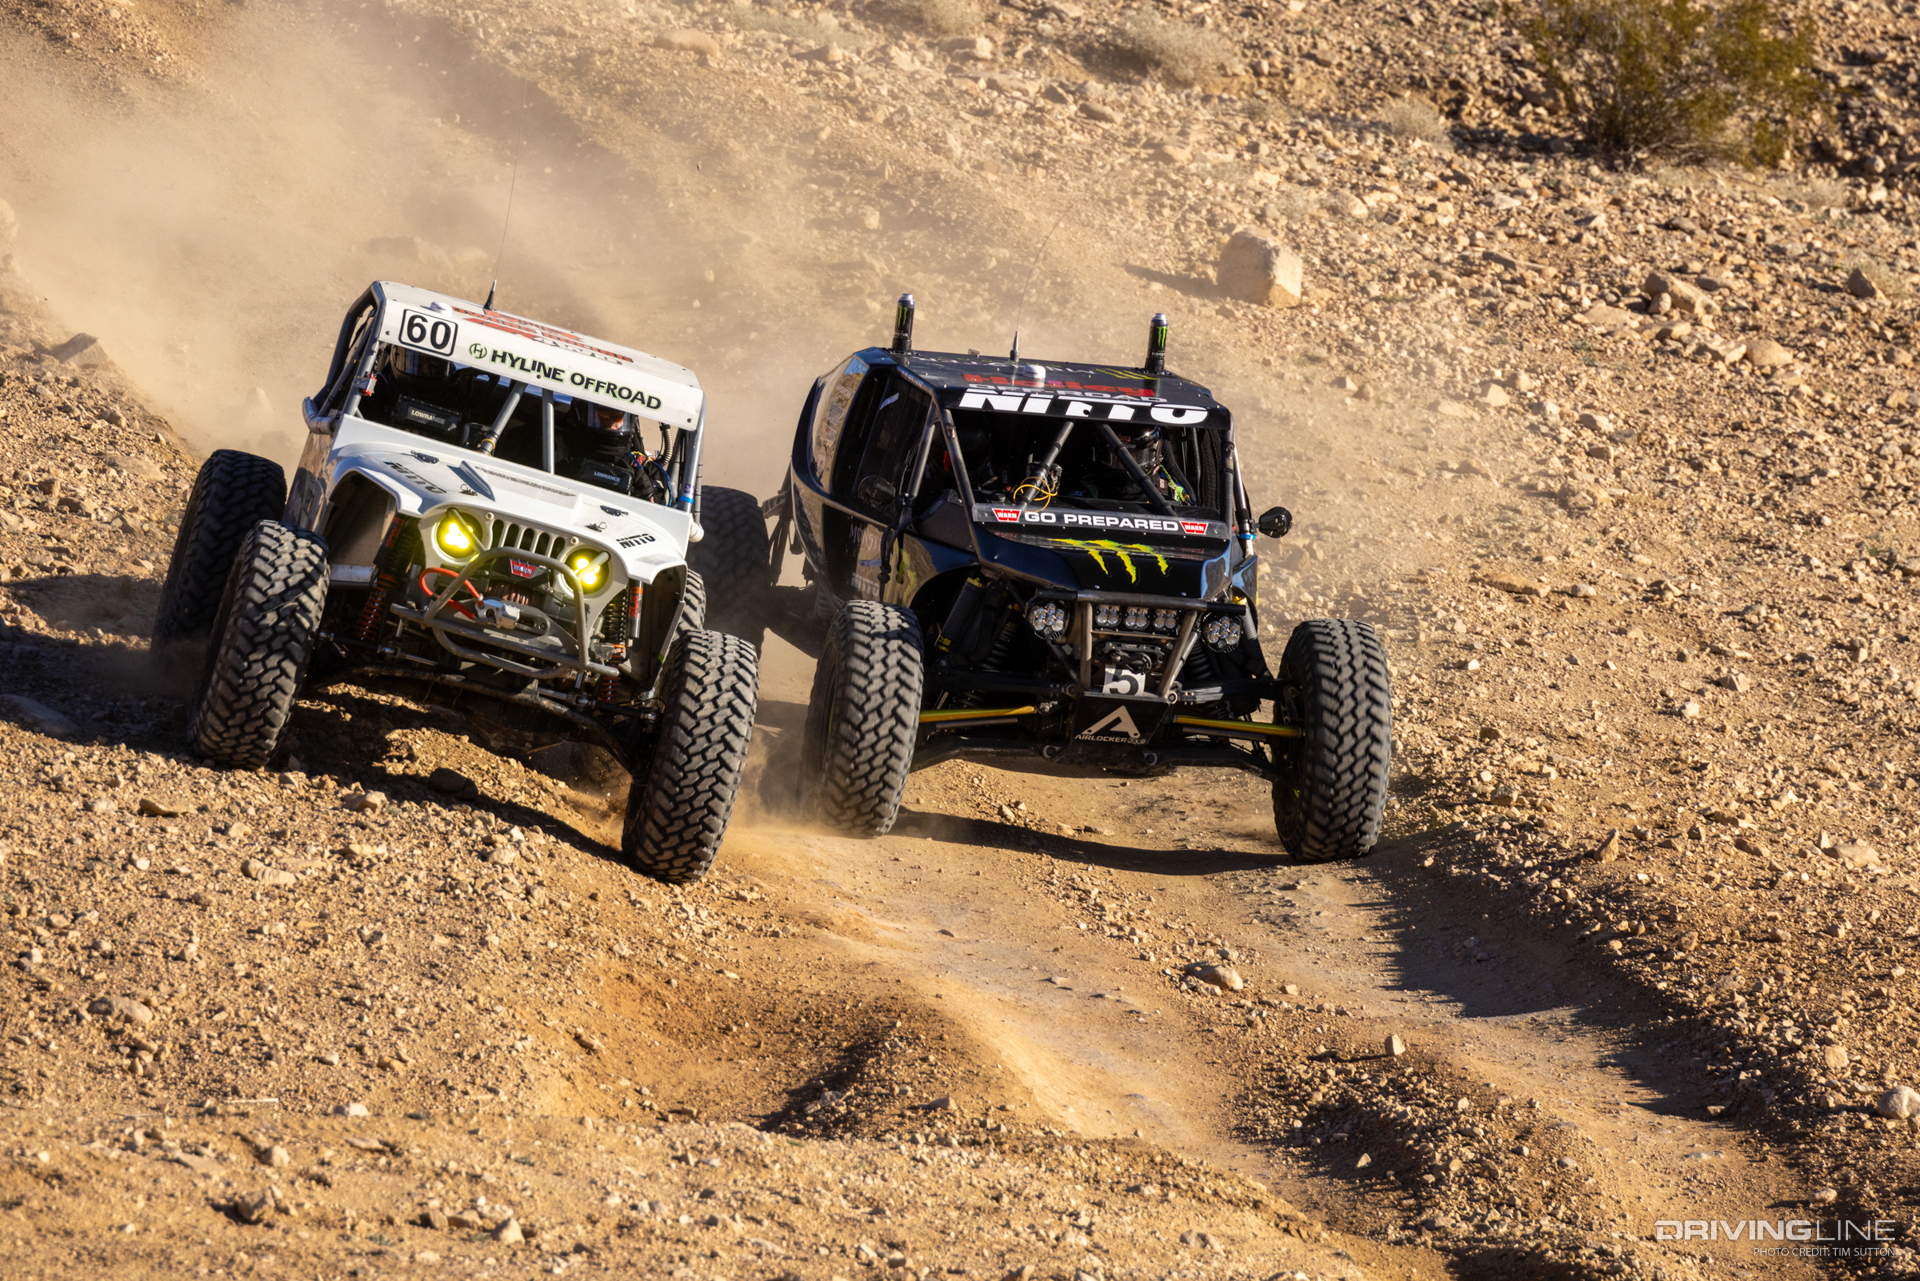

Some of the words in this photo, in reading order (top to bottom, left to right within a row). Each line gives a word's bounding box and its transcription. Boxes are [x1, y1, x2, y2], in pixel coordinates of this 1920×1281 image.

[406, 314, 452, 350] 60
[490, 349, 565, 383] HYLINE
[569, 371, 662, 410] OFFROAD
[959, 388, 1208, 425] NITTO
[410, 409, 446, 425] LOWRANCE
[593, 470, 621, 483] LOWRANCE
[997, 511, 1018, 520] WARN
[1024, 511, 1056, 523] GO
[1064, 513, 1179, 532] PREPARED
[1184, 523, 1205, 533] WARN
[615, 533, 656, 549] NITTO
[849, 523, 882, 552] MONST
[513, 564, 532, 575] WARN
[1110, 668, 1139, 696] 5
